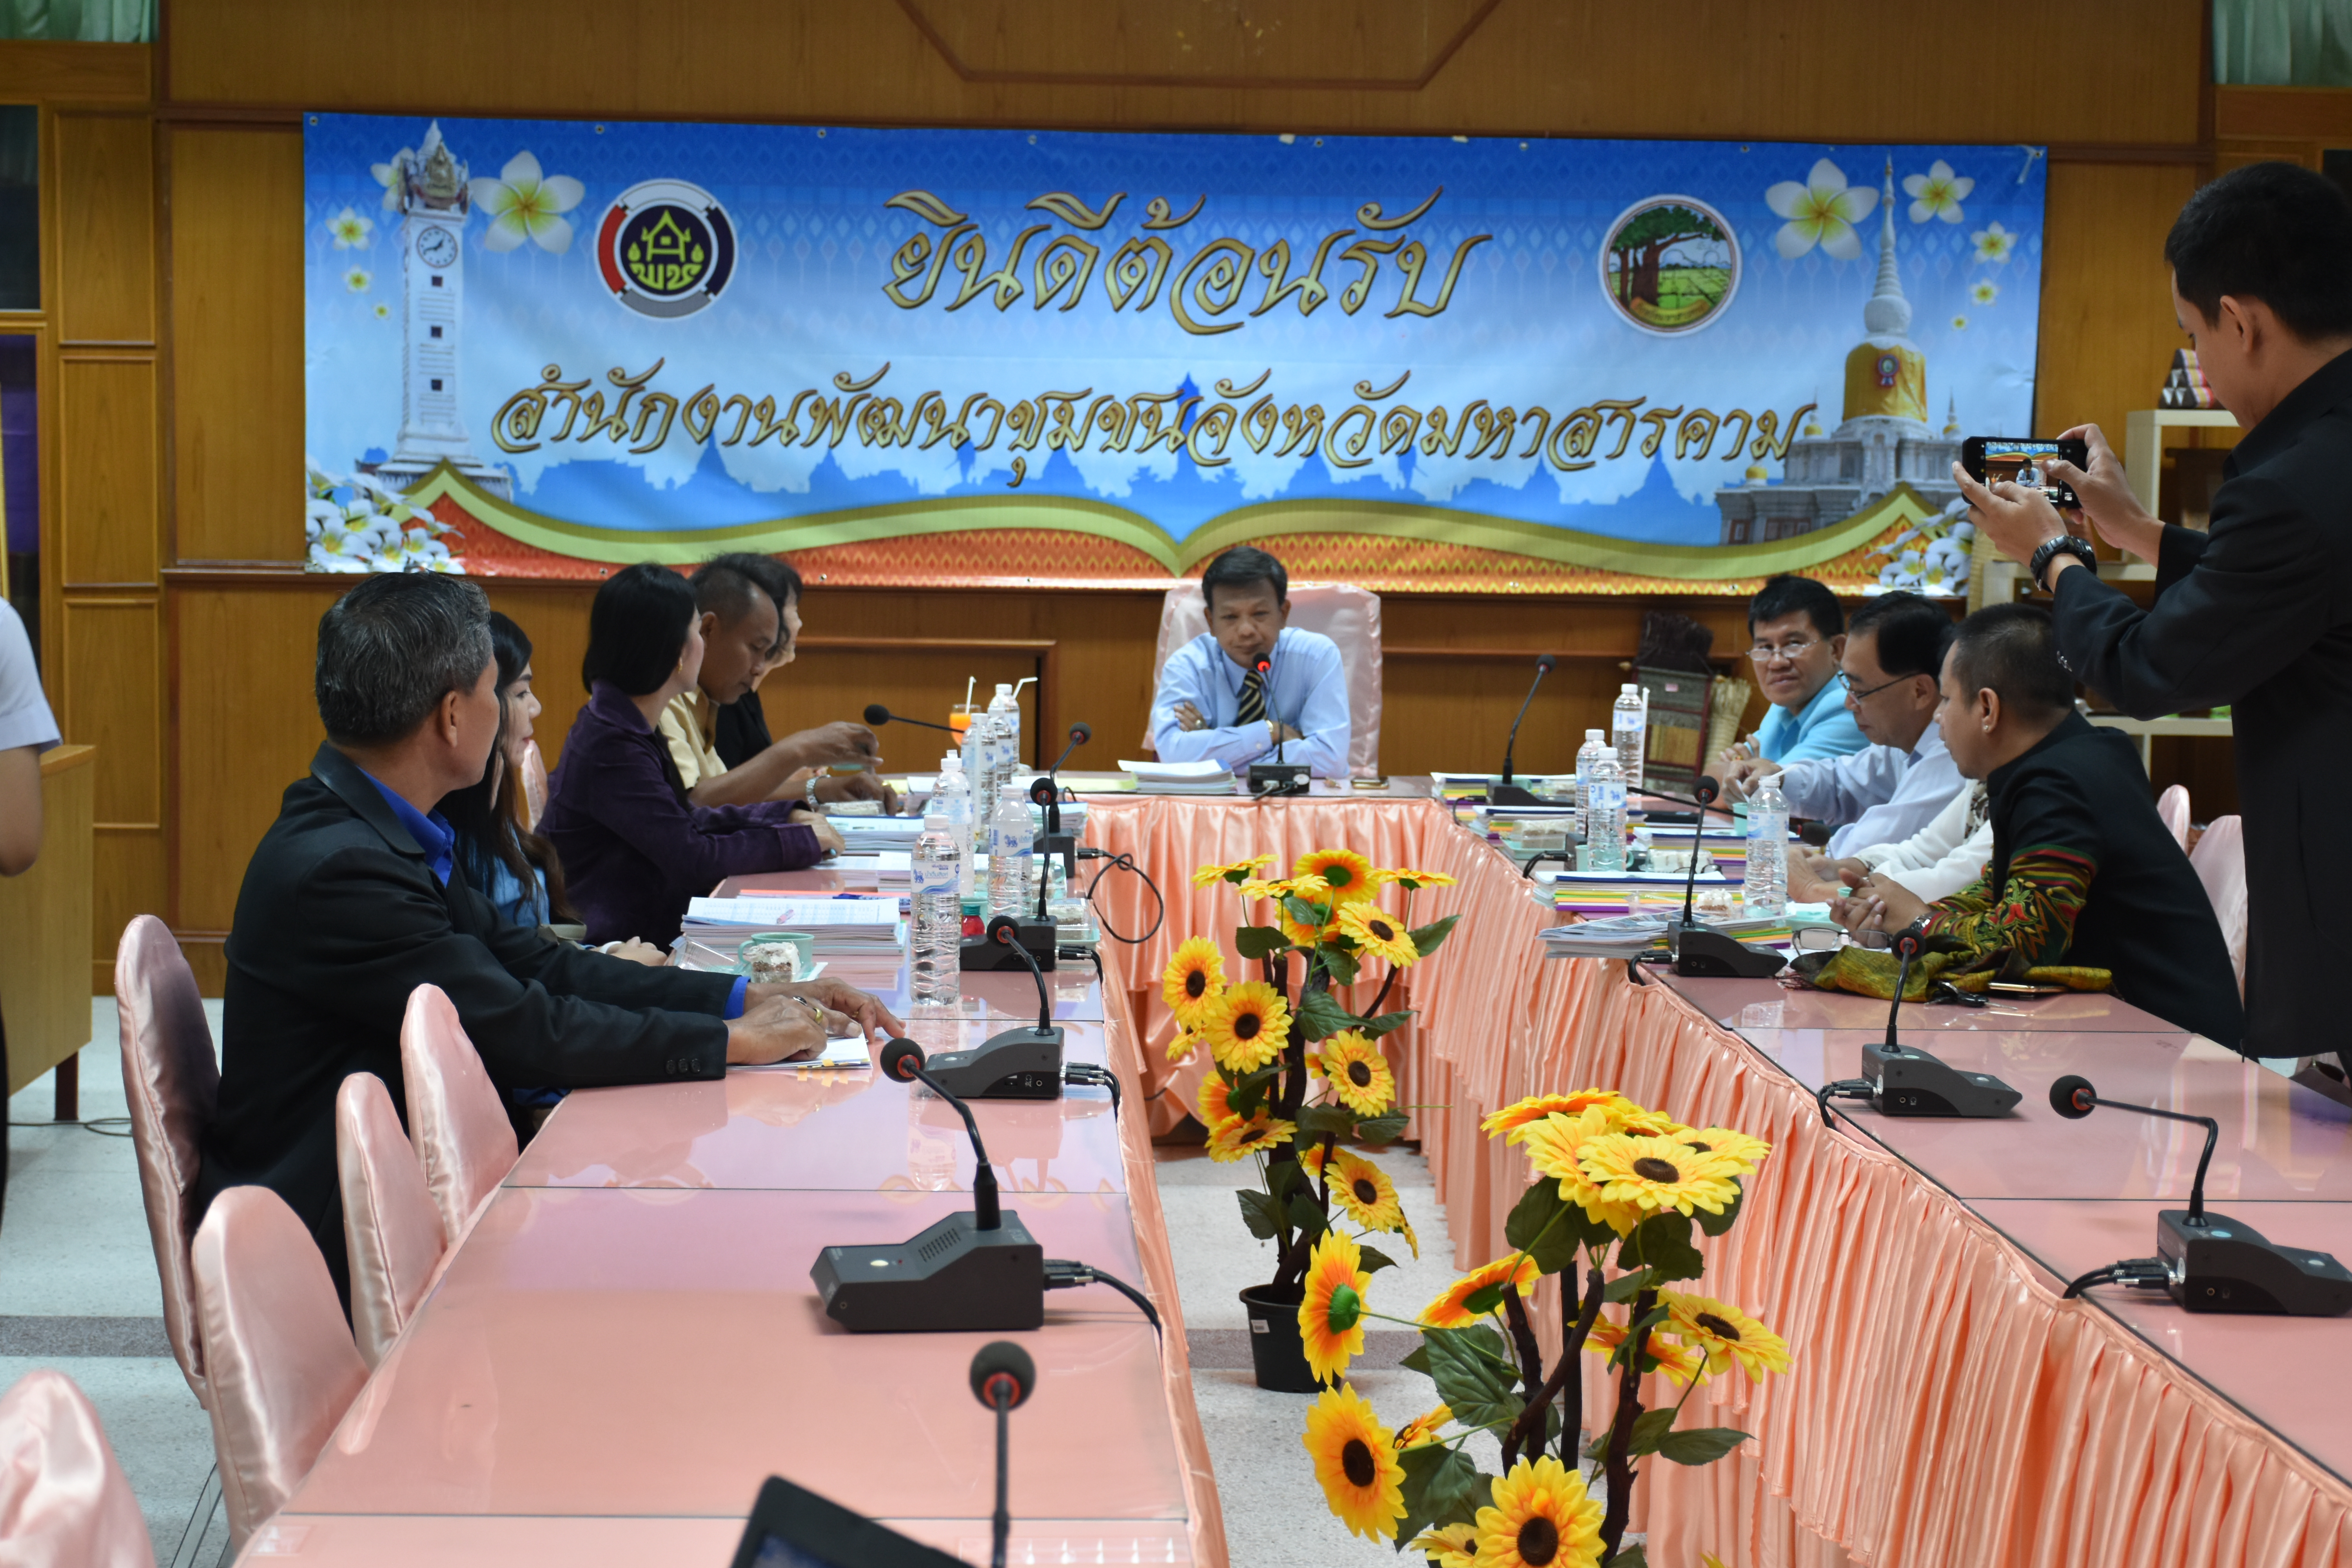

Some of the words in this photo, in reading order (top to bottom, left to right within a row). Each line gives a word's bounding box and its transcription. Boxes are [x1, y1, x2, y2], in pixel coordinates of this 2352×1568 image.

[882, 185, 1493, 336] ยินดีต้อนรับ
[491, 357, 1818, 488] สำนักงานพัฒนาชุมชนจังหวัดมหาสารคาม
